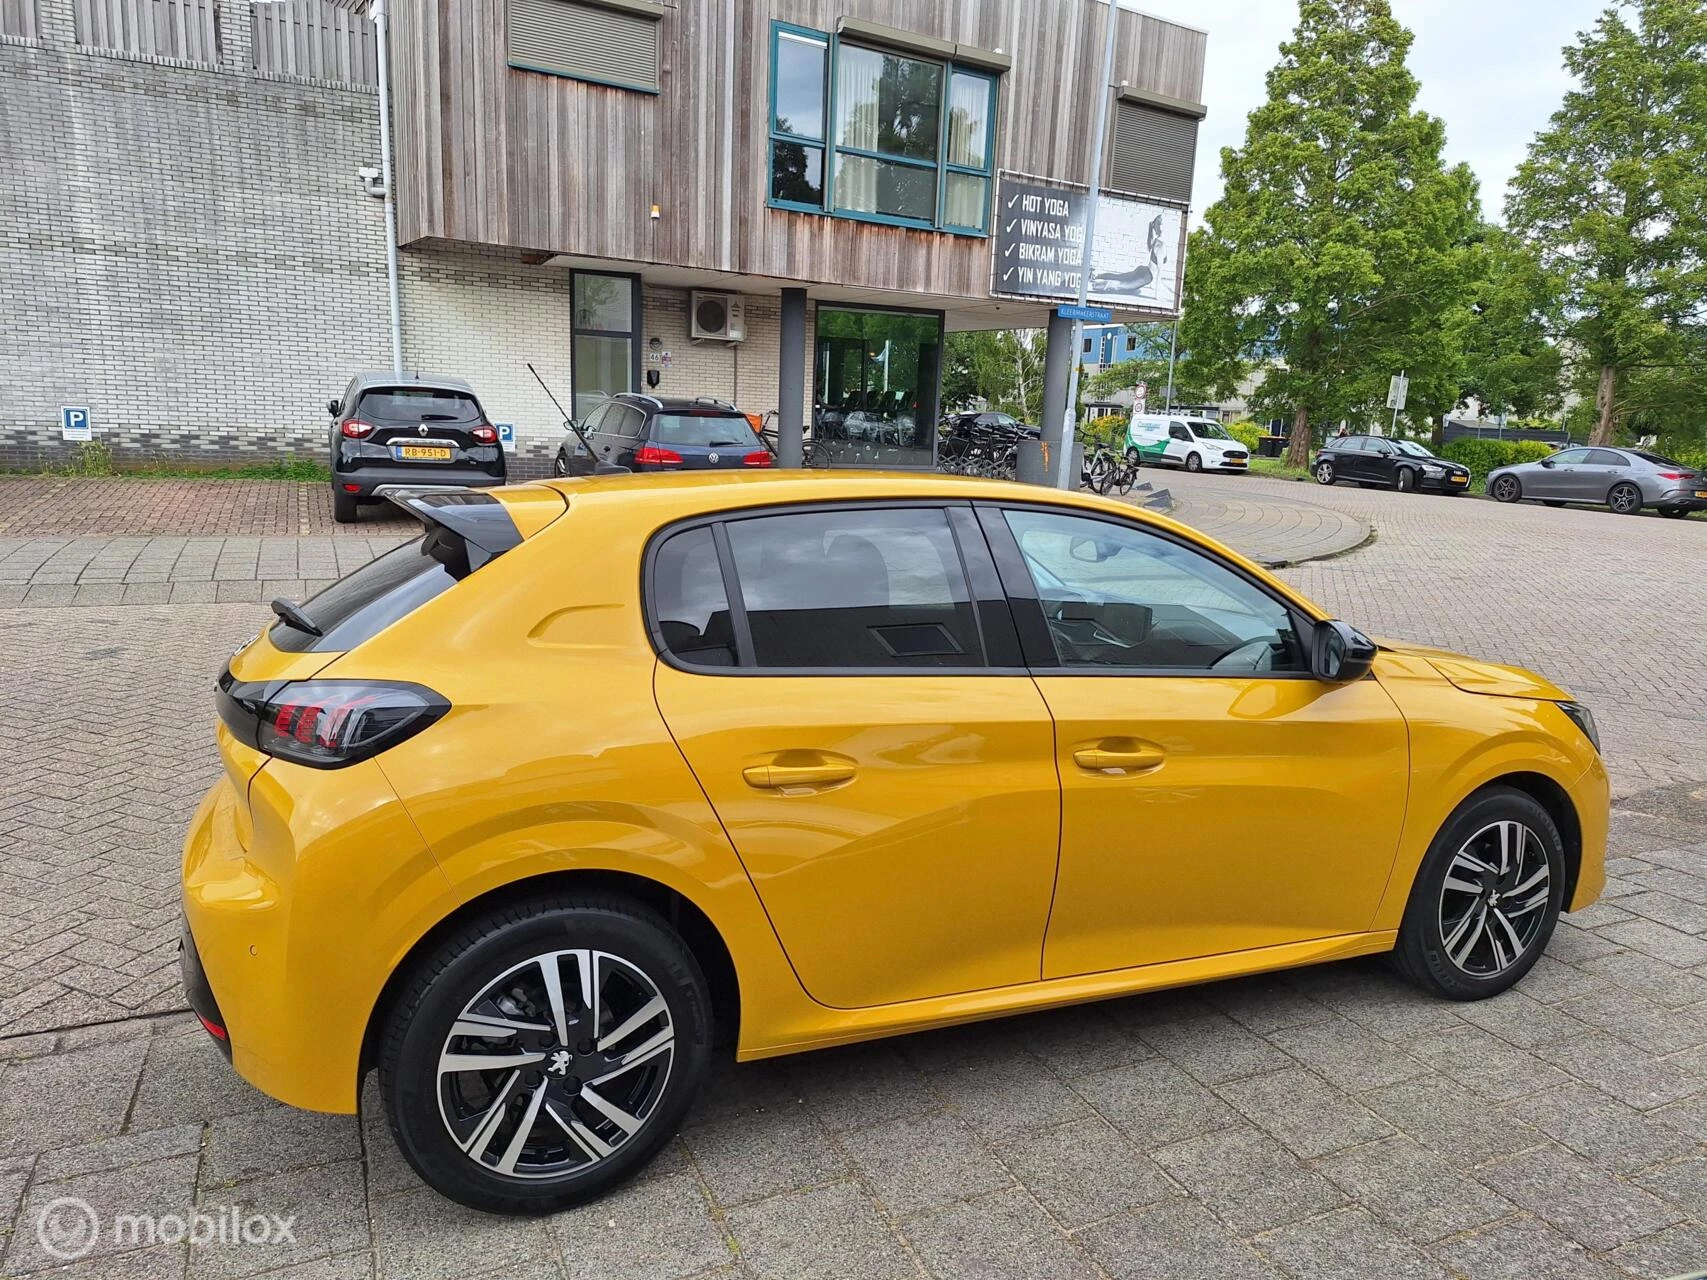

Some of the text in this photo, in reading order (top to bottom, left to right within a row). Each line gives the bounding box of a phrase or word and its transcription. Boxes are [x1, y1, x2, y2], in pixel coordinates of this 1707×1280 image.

[1022, 194, 1069, 217] HOT YOGA
[1021, 218, 1083, 243] VINYASA YOG
[1019, 243, 1055, 262] BIKRAM
[1017, 266, 1082, 288] YIN YANG YOG
[69, 411, 84, 427] P
[499, 426, 510, 440] P
[404, 448, 447, 457] RB-951-D
